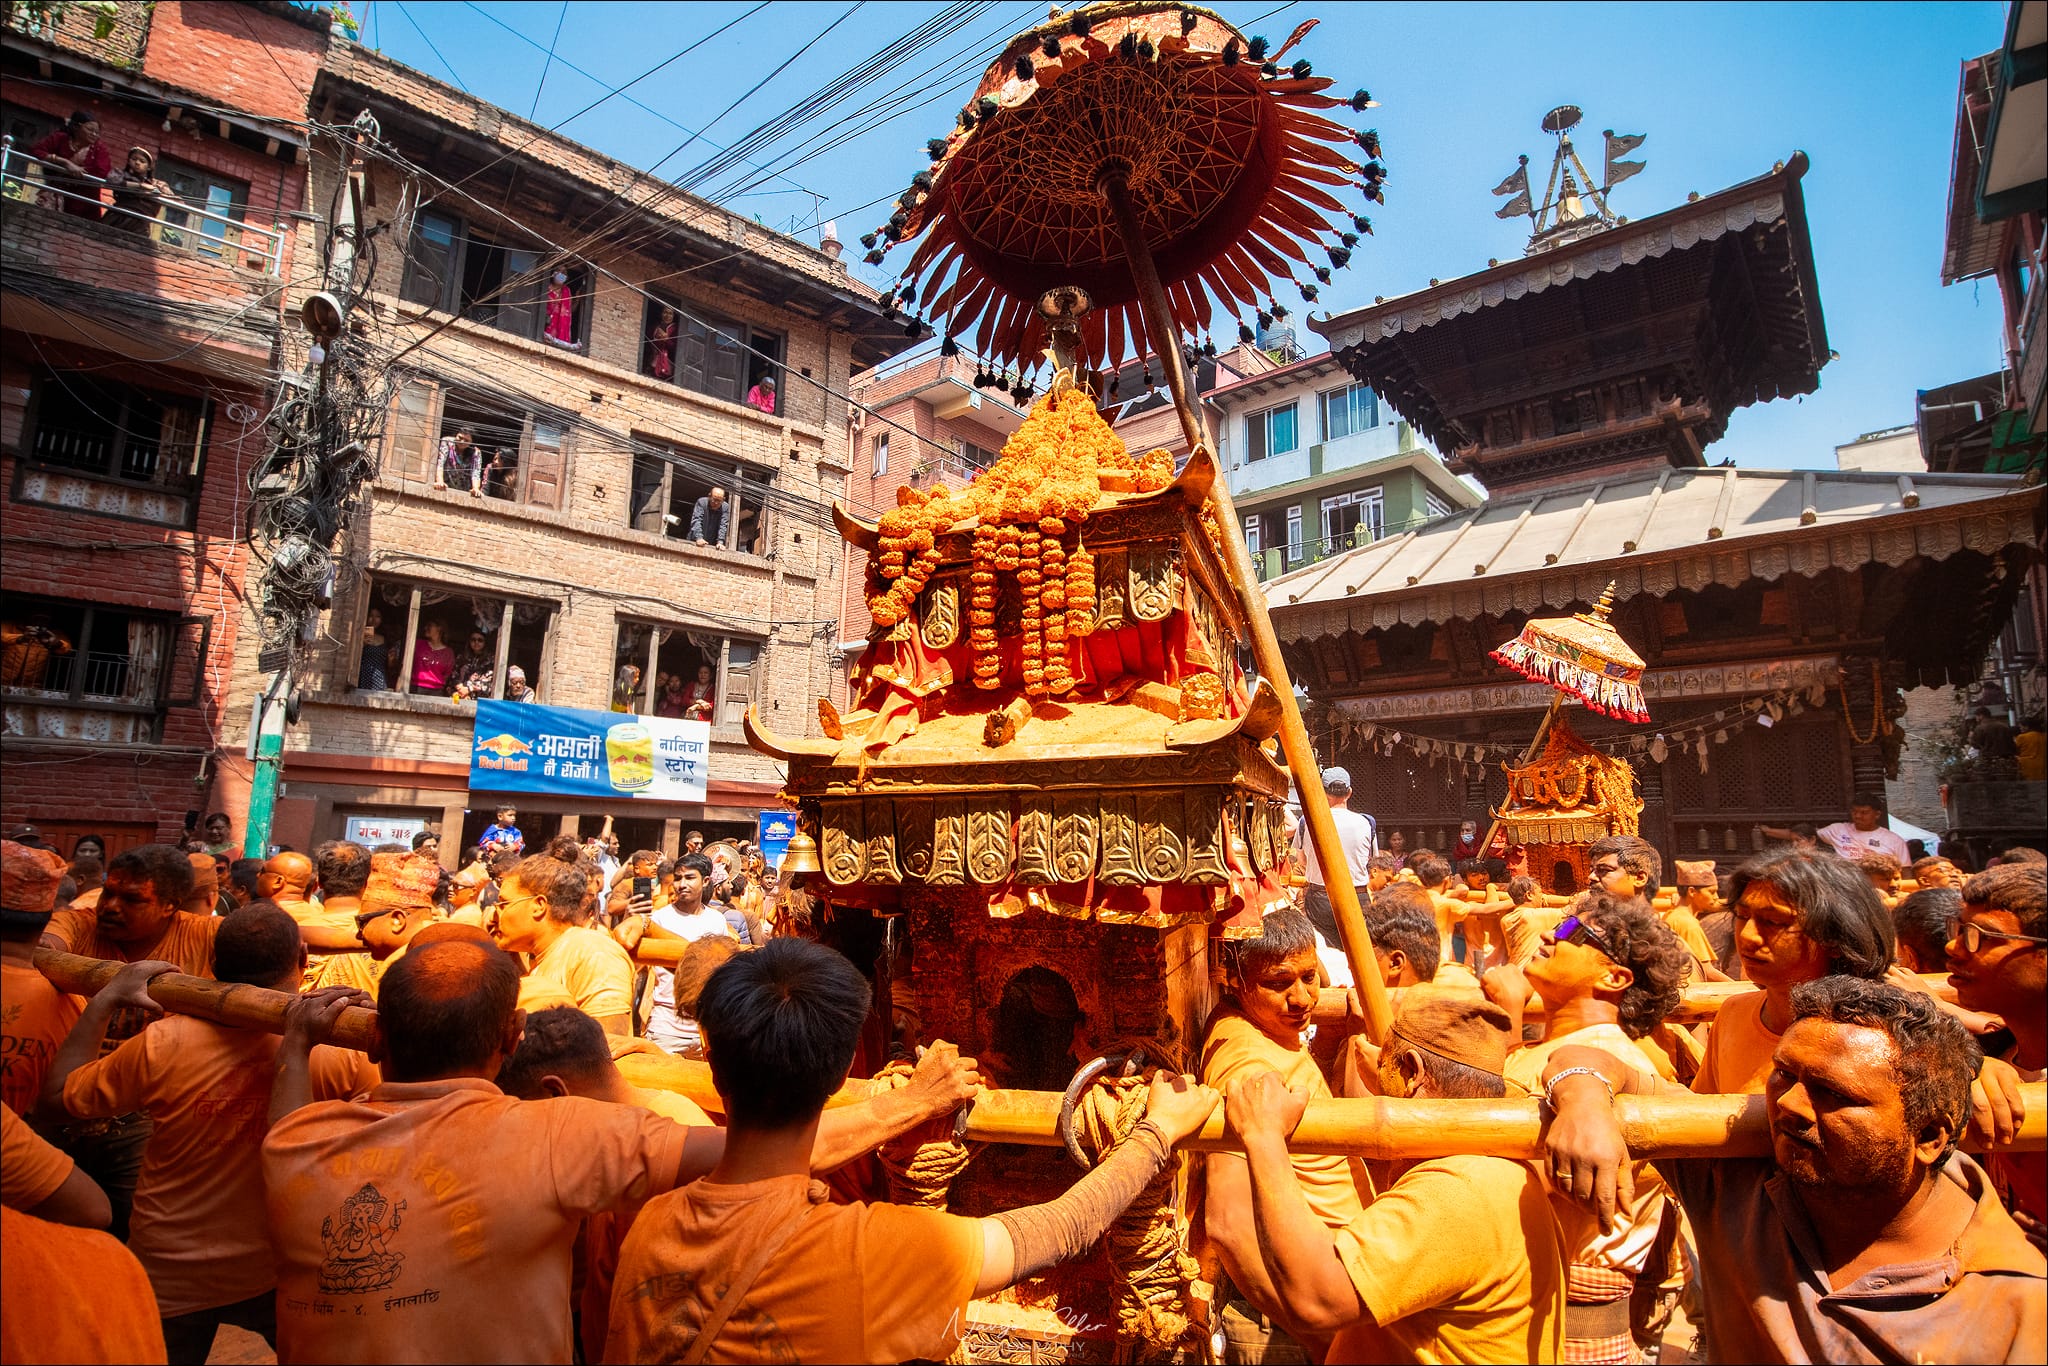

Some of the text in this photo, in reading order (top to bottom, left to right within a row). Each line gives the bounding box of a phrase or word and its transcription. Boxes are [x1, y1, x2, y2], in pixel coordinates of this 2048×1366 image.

[537, 734, 602, 760] असली
[660, 736, 704, 753] नानिचा
[479, 755, 529, 772] Red Bull
[543, 758, 558, 777] नै
[665, 757, 697, 776] स्टोर
